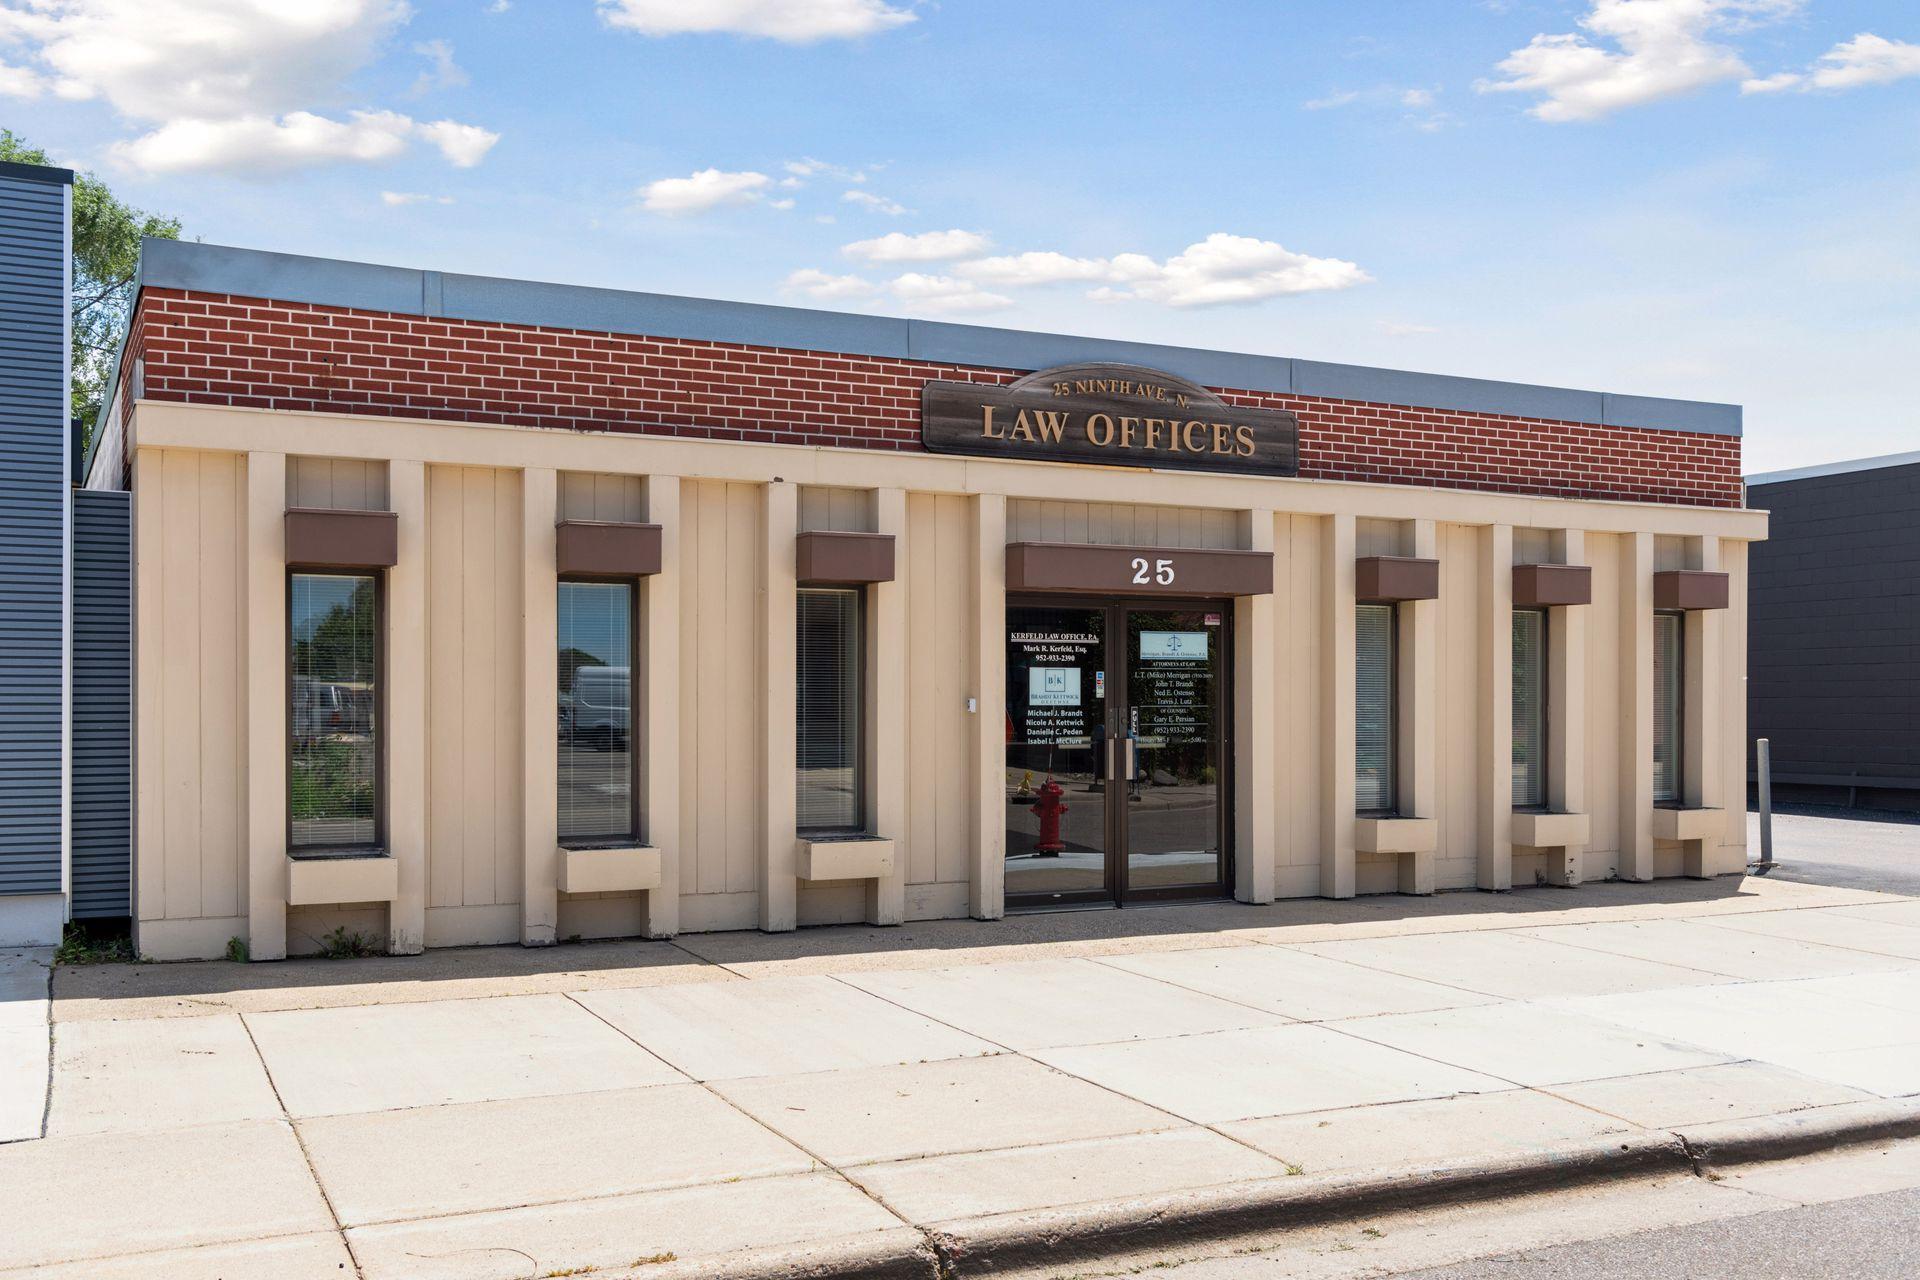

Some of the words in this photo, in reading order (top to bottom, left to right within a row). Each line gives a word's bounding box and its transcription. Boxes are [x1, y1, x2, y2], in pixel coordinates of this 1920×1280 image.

[1052, 382, 1070, 398] 25
[1075, 379, 1131, 396] NINTH
[1135, 383, 1170, 402] AVE.
[1175, 393, 1191, 410] N.
[980, 404, 1071, 444] LAW
[1086, 413, 1256, 457] OFFICES
[1131, 557, 1175, 585] 25
[1010, 632, 1044, 640] KERFELD
